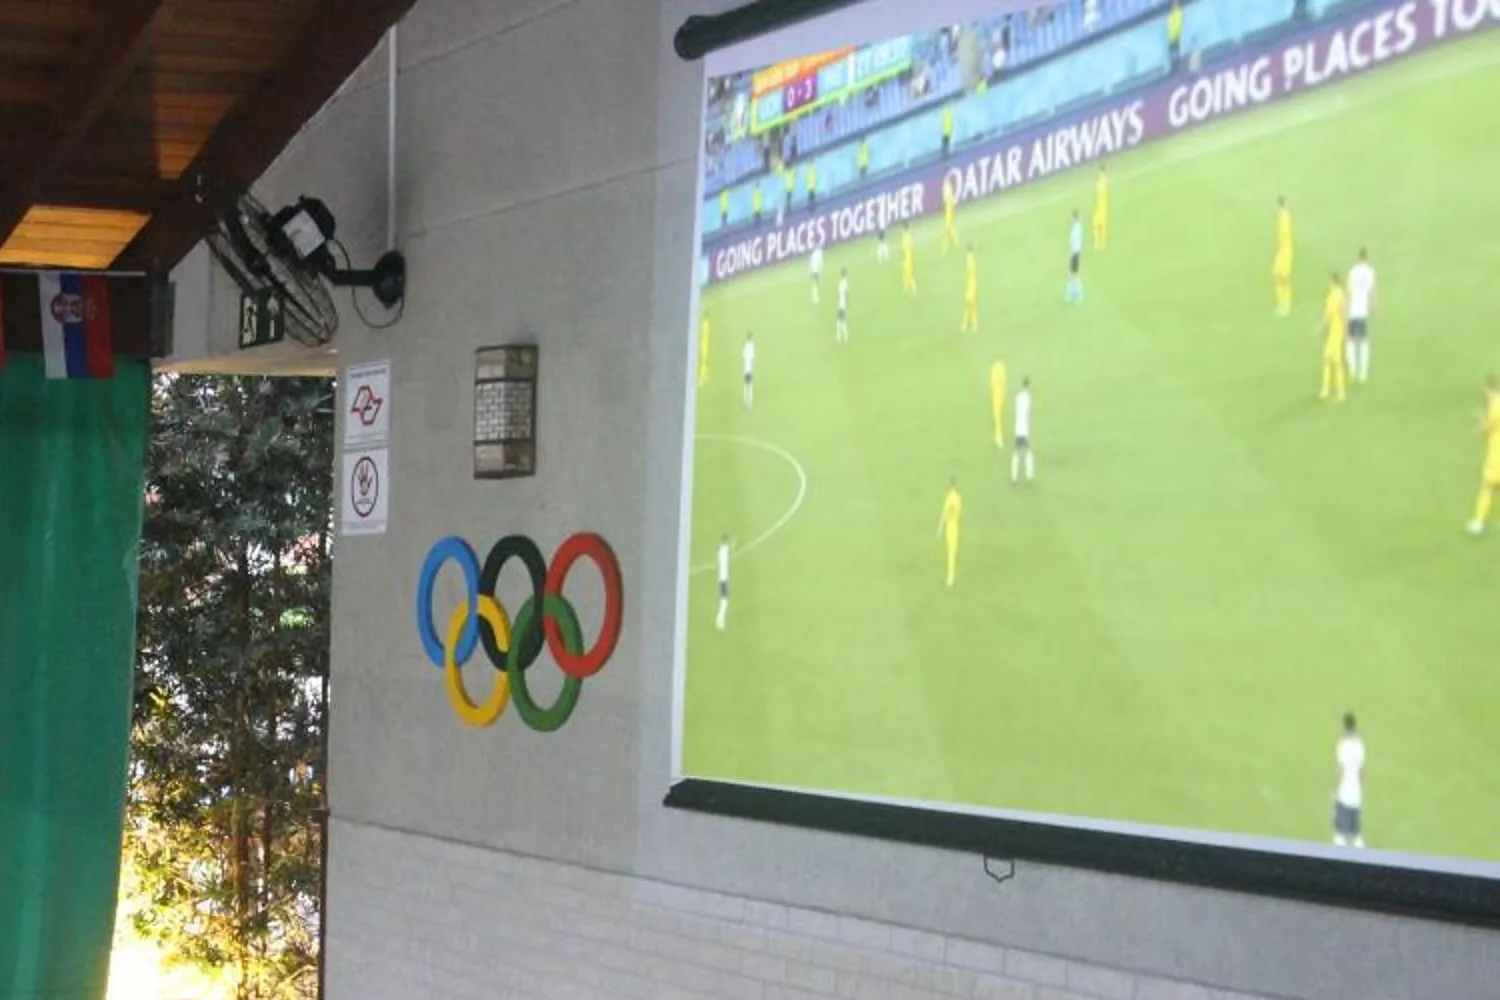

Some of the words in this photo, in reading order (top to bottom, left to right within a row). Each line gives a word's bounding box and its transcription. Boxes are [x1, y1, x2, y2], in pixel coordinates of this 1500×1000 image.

[716, 236, 762, 278] GOING
[766, 215, 826, 262] PLACES
[830, 181, 925, 241] TOGETHER
[942, 145, 1023, 205] QATAR
[1027, 99, 1145, 179] AIRWAYS
[1168, 56, 1272, 127] GOING
[1283, 2, 1416, 91] PLACES
